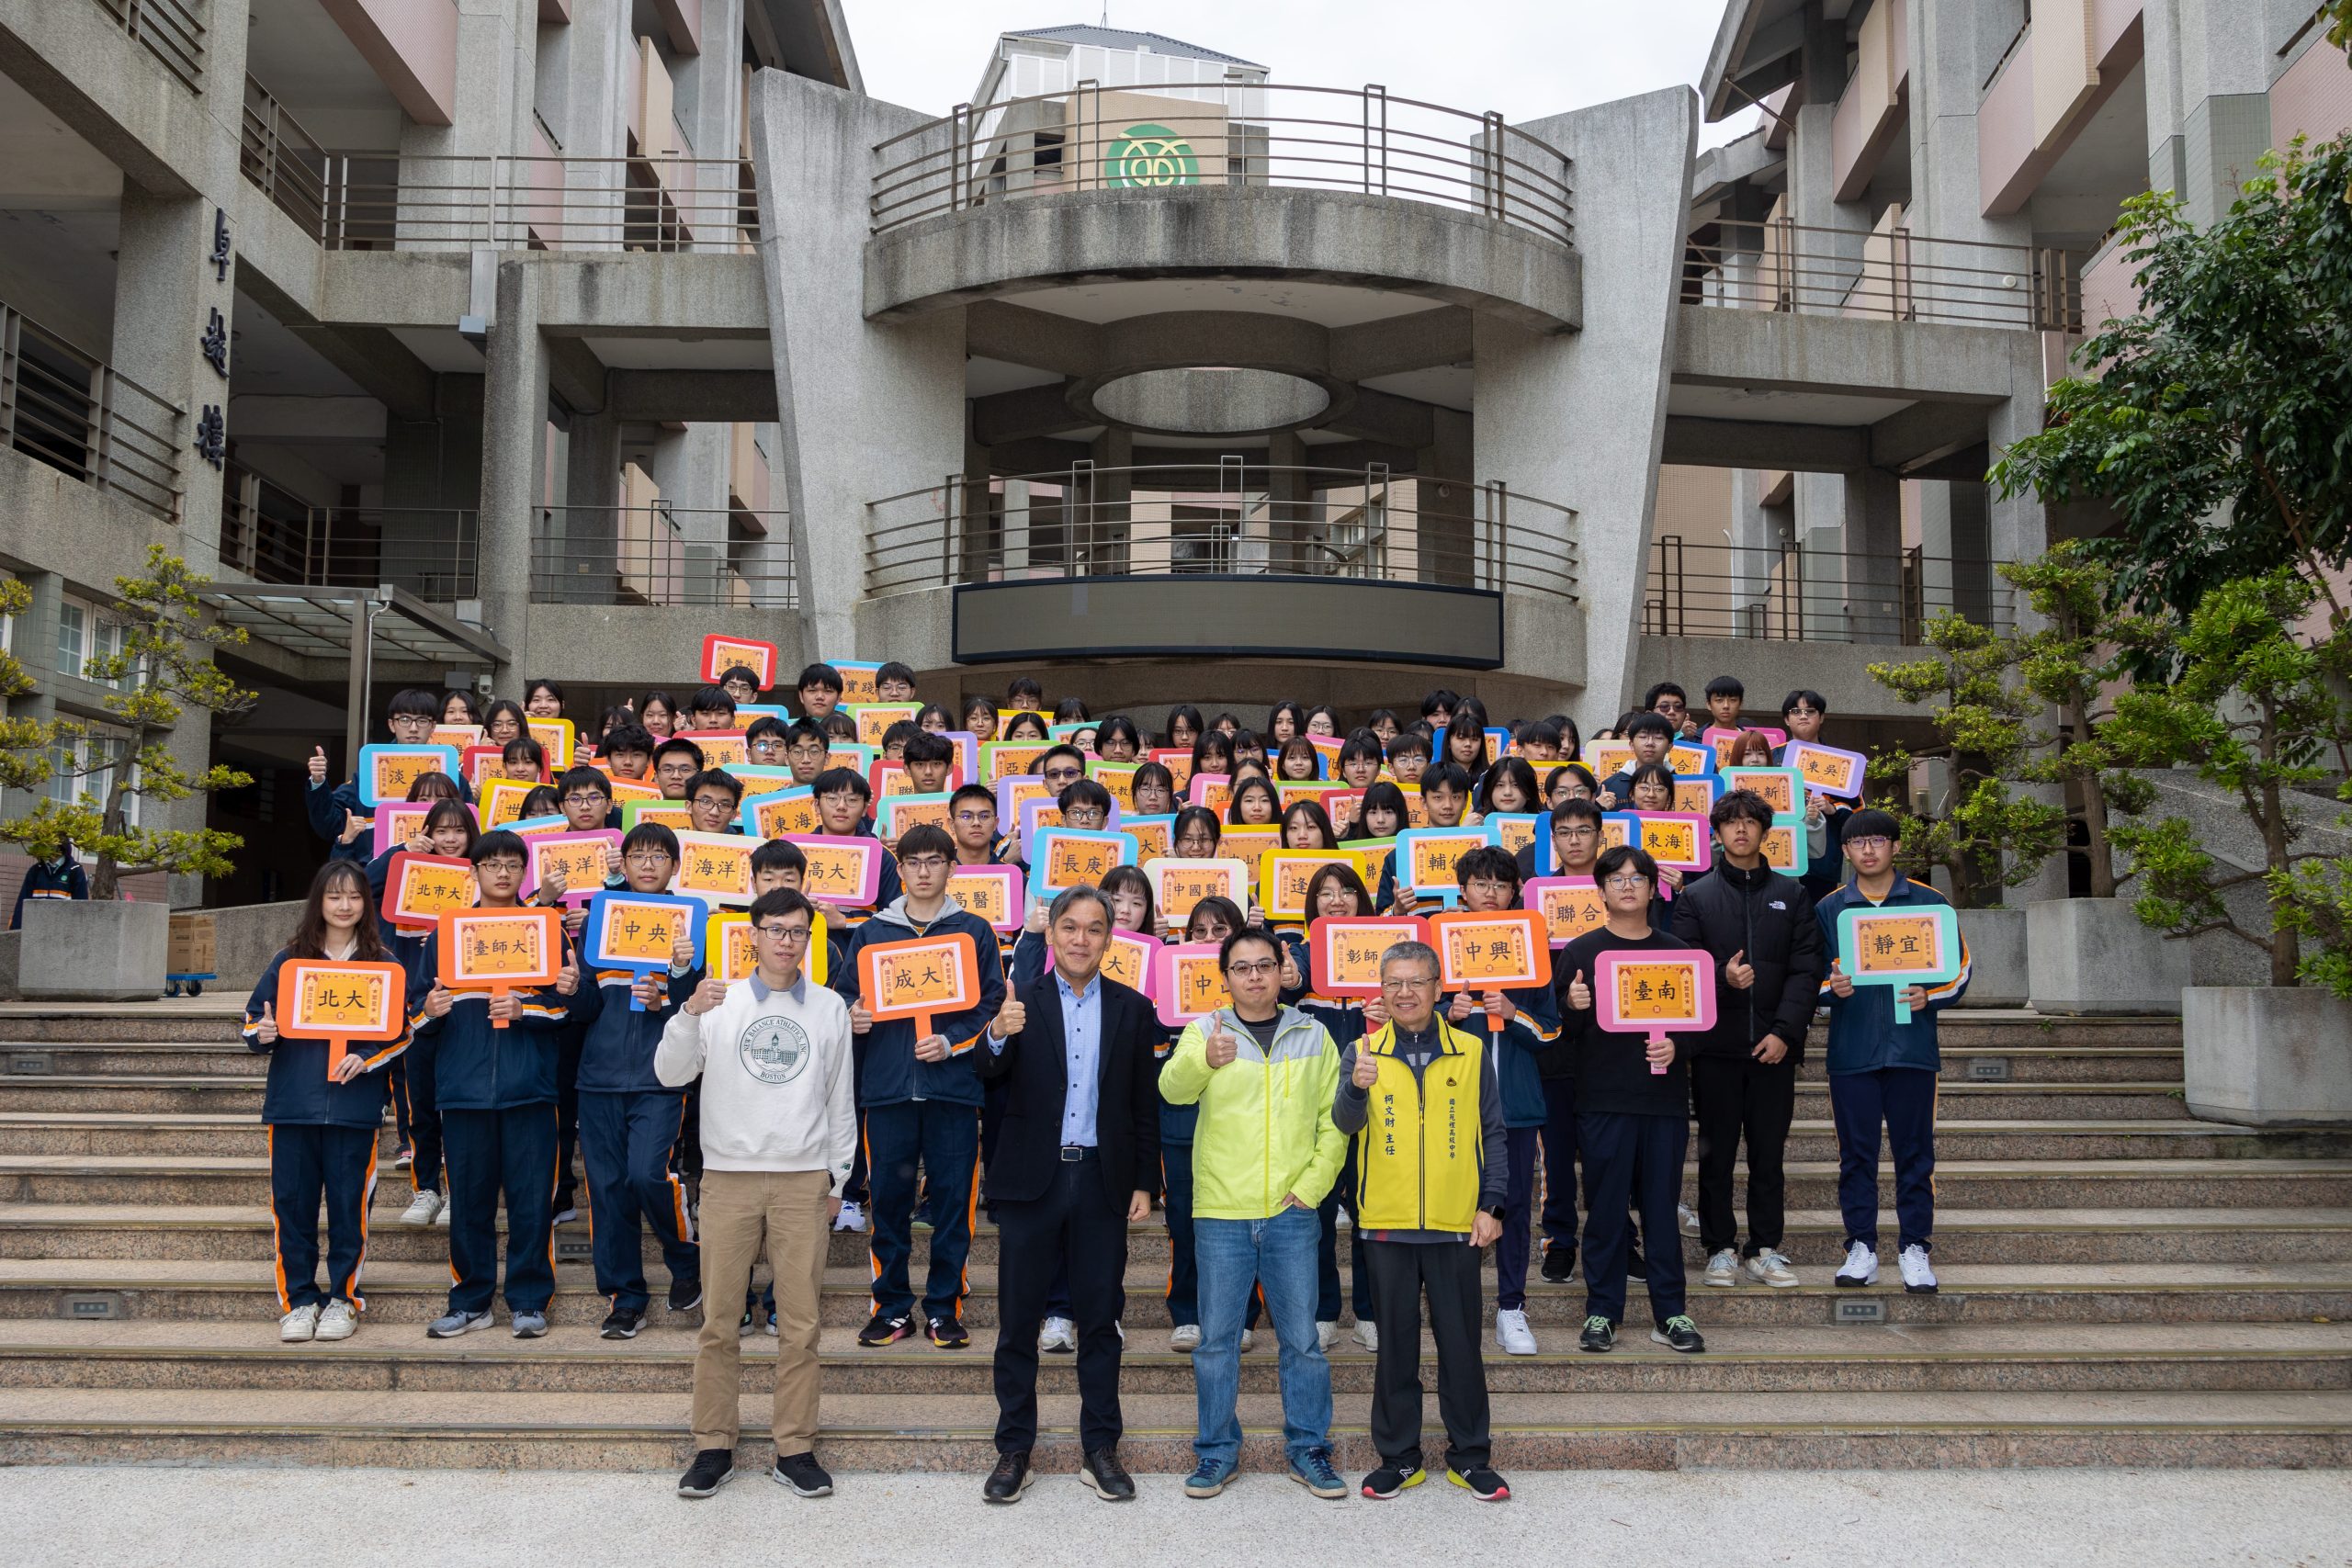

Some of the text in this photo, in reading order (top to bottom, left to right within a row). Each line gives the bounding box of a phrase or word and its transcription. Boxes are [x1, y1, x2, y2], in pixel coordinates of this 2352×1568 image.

[846, 680, 875, 694] 實踐
[704, 750, 732, 765] 南華
[490, 769, 503, 779] 淡
[1611, 761, 1623, 773] 亞
[1807, 761, 1838, 777] 東吳
[899, 785, 913, 796] 聯
[1107, 785, 1134, 796] 北教
[506, 803, 521, 817] 世
[1408, 809, 1421, 824] 宜
[775, 812, 812, 833] 東海
[1139, 839, 1156, 855] 大
[1514, 835, 1530, 852] 暨
[1646, 832, 1681, 849] 東海
[1767, 840, 1780, 855] 守
[552, 856, 594, 876] 海洋
[695, 859, 736, 878] 海洋
[808, 861, 846, 880] 高大
[1063, 853, 1102, 874] 長庚
[417, 884, 461, 900] 北市大
[1174, 882, 1217, 897] 中國醫
[1290, 876, 1307, 896] 逢
[1556, 903, 1600, 923] 聯合
[625, 920, 667, 942] 中央
[474, 939, 527, 956] 臺師大
[1466, 941, 1511, 962] 中興
[1874, 933, 1919, 955] 靜宜
[742, 944, 759, 963] 清
[1347, 948, 1378, 964] 彰師
[895, 965, 942, 989] 成大
[1634, 979, 1676, 1001] 臺南
[318, 989, 366, 1009] 北大
[743, 1037, 752, 1052] NEW
[748, 1019, 775, 1037] BALANCE
[760, 1071, 786, 1081] BOSTON
[1384, 1094, 1396, 1156] 柯文財 主任
